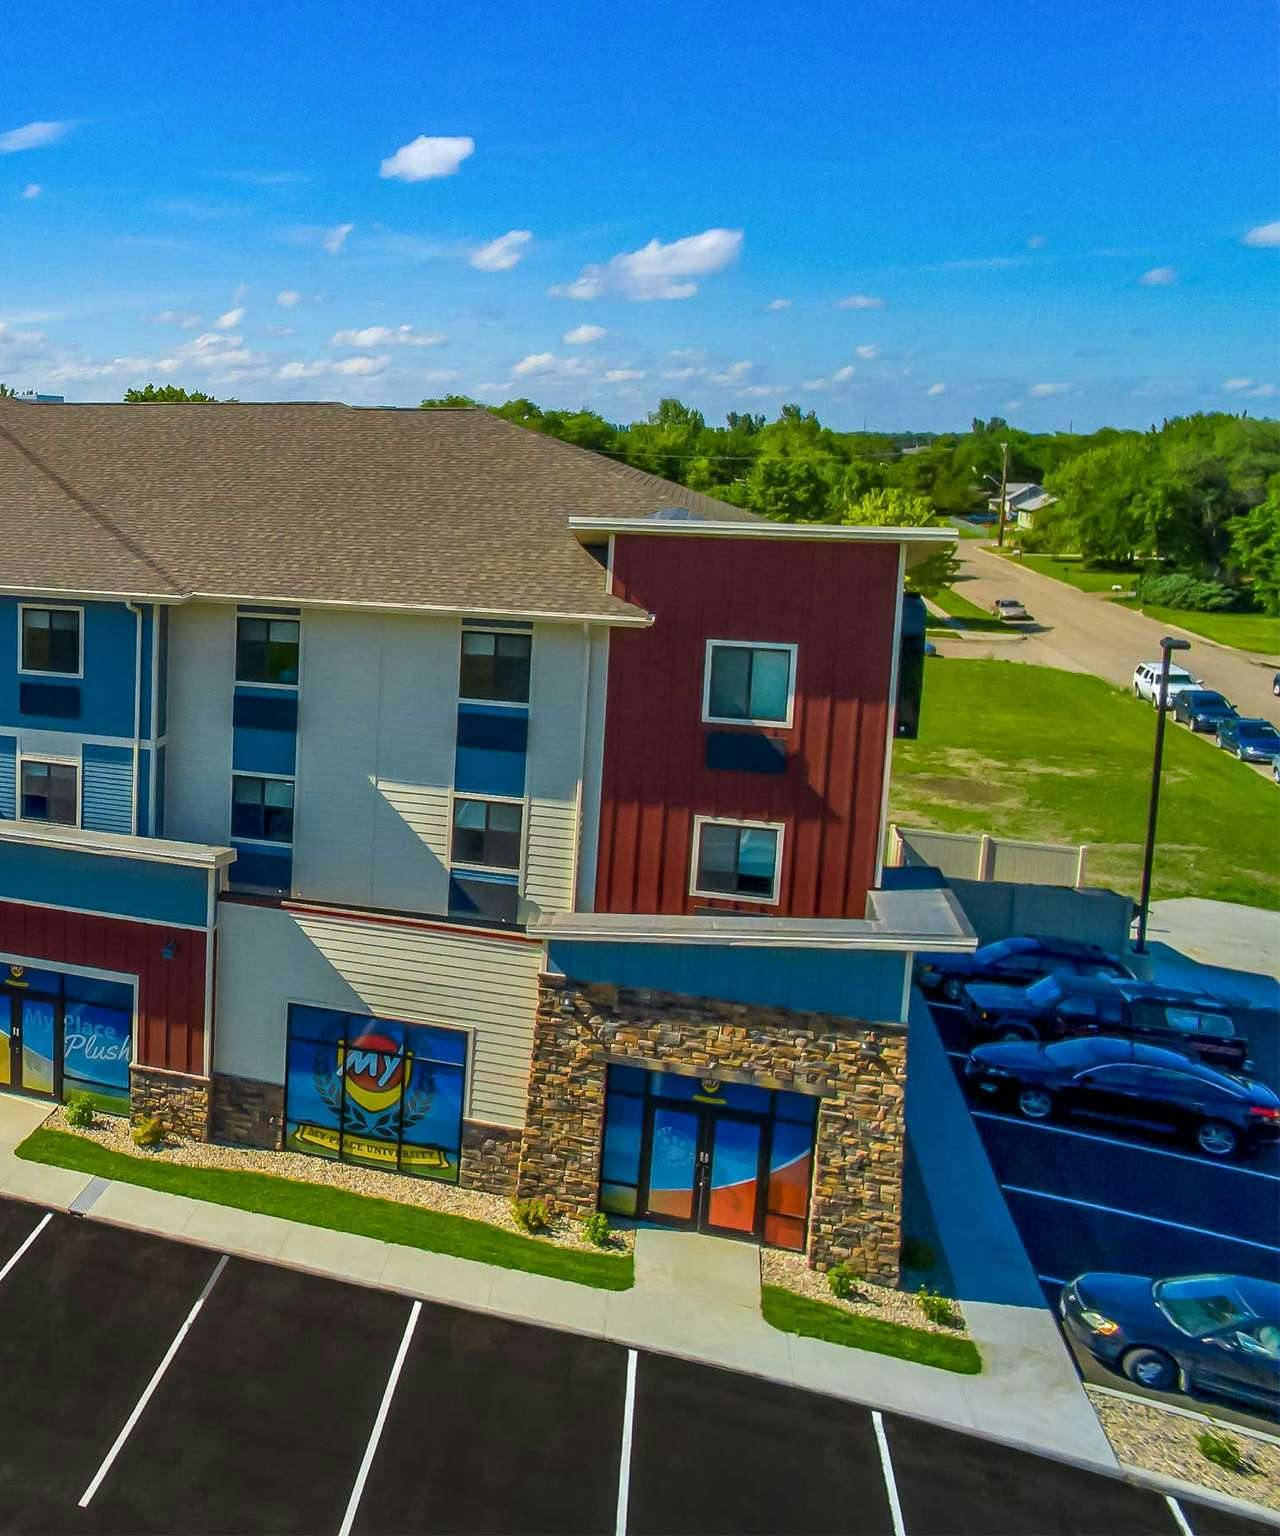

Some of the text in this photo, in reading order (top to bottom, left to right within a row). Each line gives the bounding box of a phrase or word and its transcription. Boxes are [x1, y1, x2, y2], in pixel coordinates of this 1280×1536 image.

[23, 1008, 117, 1040] My Place
[64, 1033, 131, 1062] Plush
[366, 1144, 436, 1159] UNIVRSITY
